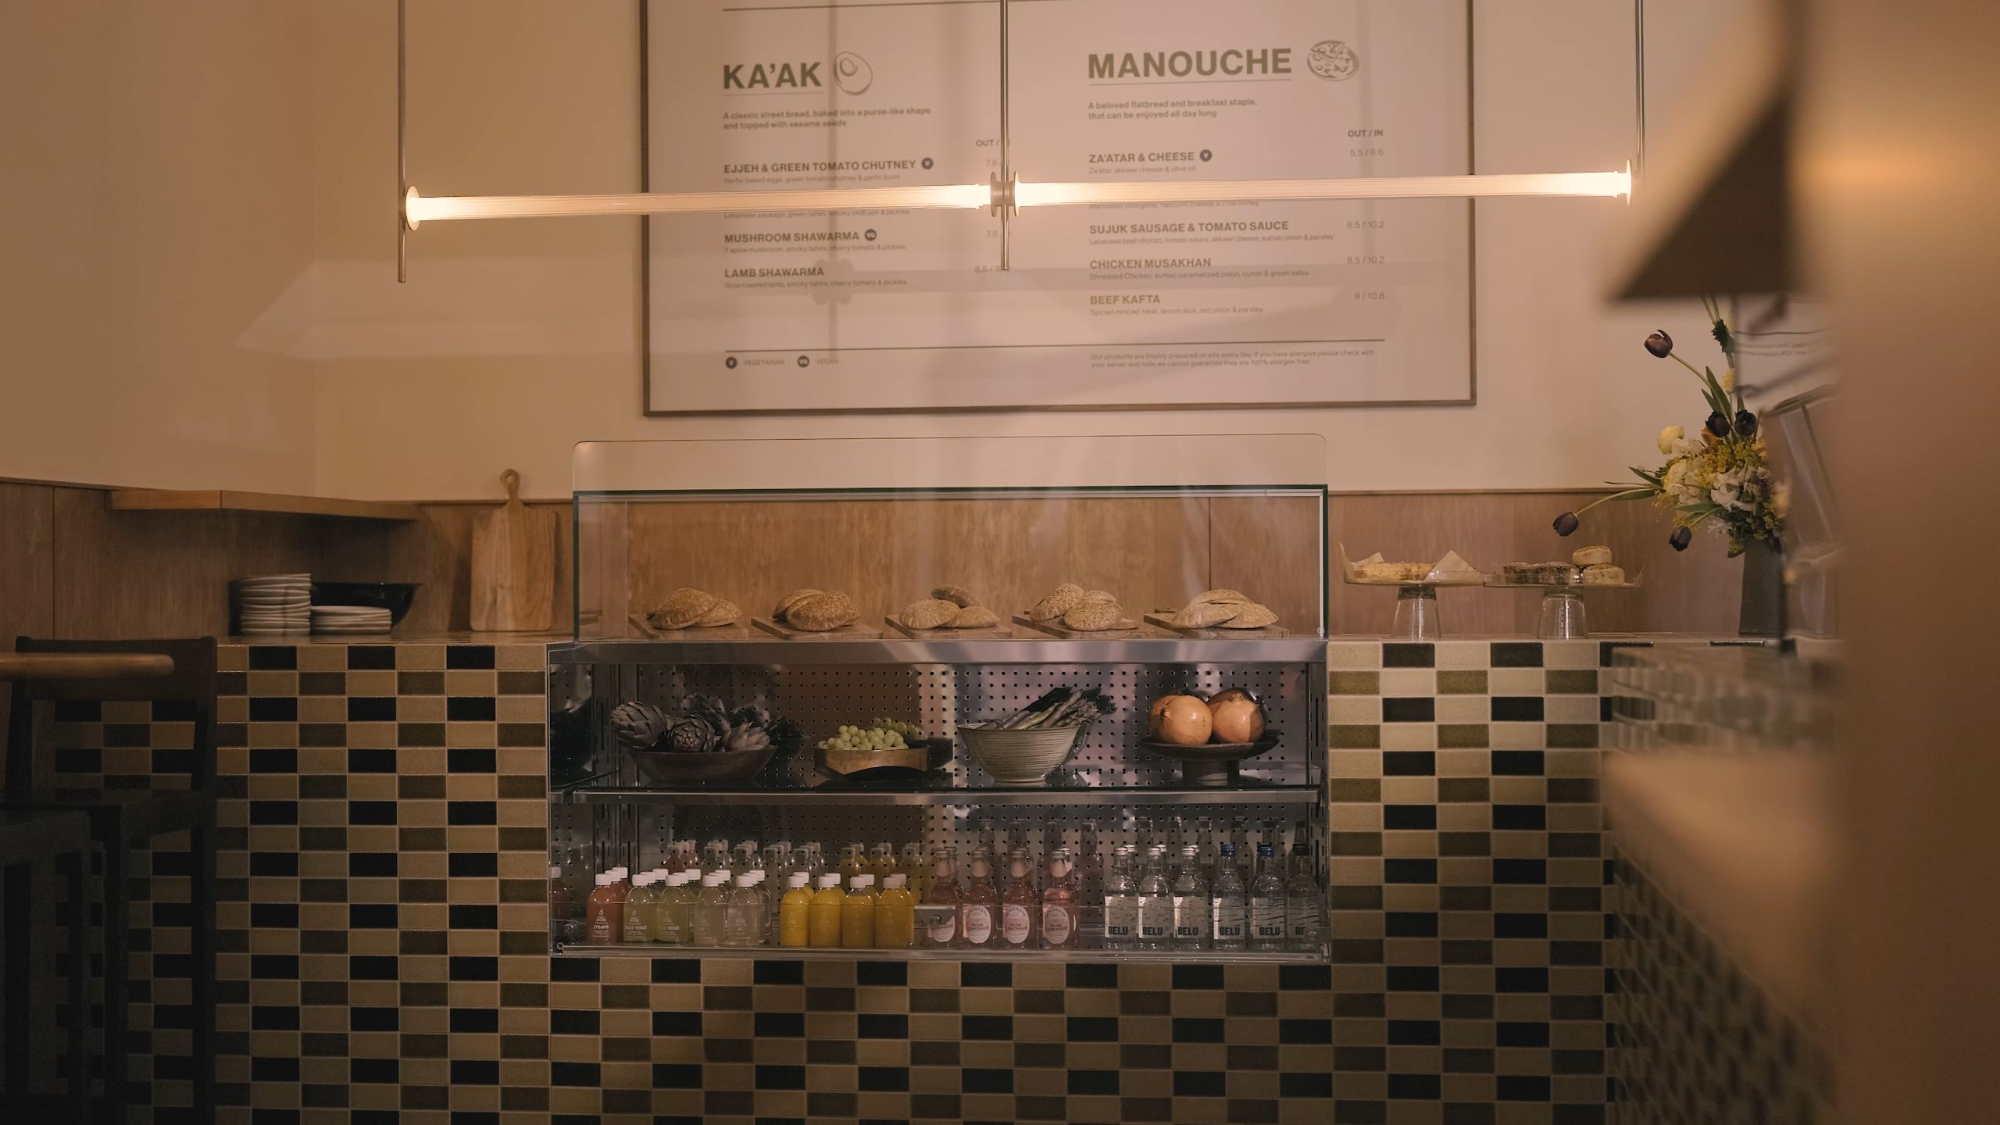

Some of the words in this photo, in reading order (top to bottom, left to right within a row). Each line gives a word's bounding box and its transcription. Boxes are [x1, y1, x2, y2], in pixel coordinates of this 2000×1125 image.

[1088, 48, 1293, 79] MANOUCHE
[722, 61, 823, 90] KA'AK
[1096, 101, 1130, 109] beloved
[1130, 100, 1169, 108] flatbread
[1187, 99, 1227, 107] breakfast
[730, 111, 759, 119] classic
[760, 110, 784, 118] street
[812, 109, 838, 117] baked
[863, 108, 905, 118] purse-like
[906, 107, 931, 117] shape
[1088, 112, 1105, 120] that
[1123, 111, 1134, 119] be
[1135, 111, 1169, 120] enjoyed
[1170, 110, 1180, 118] all
[1181, 110, 1197, 119] day
[1198, 110, 1217, 119] long
[723, 122, 738, 130] and
[740, 121, 769, 131] topped
[822, 119, 847, 127] seeds
[1347, 129, 1366, 138] OUT
[1373, 129, 1383, 137] IN
[975, 139, 994, 148] OUT
[1088, 153, 1136, 163] ZA'ATAR
[1137, 153, 1145, 162] &
[1148, 151, 1195, 162] CHEESE
[724, 164, 759, 174] EJJEH
[761, 163, 768, 173] &
[771, 162, 810, 172] GREEN
[812, 161, 859, 171] TOMATO
[861, 160, 916, 170] CHUTNEY
[1089, 224, 1128, 234] SUJUK
[1130, 223, 1185, 233] SAUSAGE
[1187, 223, 1195, 232] &
[1197, 222, 1247, 232] TOMATO
[1249, 221, 1289, 231] SAUCE
[1367, 220, 1385, 229] 10.2
[724, 233, 791, 243] MUSHROOM
[793, 231, 860, 242] SHAWARMA
[1089, 259, 1142, 270] CHICKEN
[1144, 258, 1212, 268] MUSAKHAN
[1367, 255, 1385, 264] 10.2
[724, 269, 756, 278] LAMB
[758, 267, 825, 277] SHAWARMA
[1089, 295, 1120, 305] BEEF
[1122, 294, 1161, 304] KAFTA
[1368, 292, 1385, 300] 10.8
[1108, 926, 1129, 936] BELU
[1142, 926, 1163, 936] BELU
[1177, 926, 1199, 936] BELU
[1219, 926, 1240, 936] BELU
[1259, 926, 1280, 936] BELU
